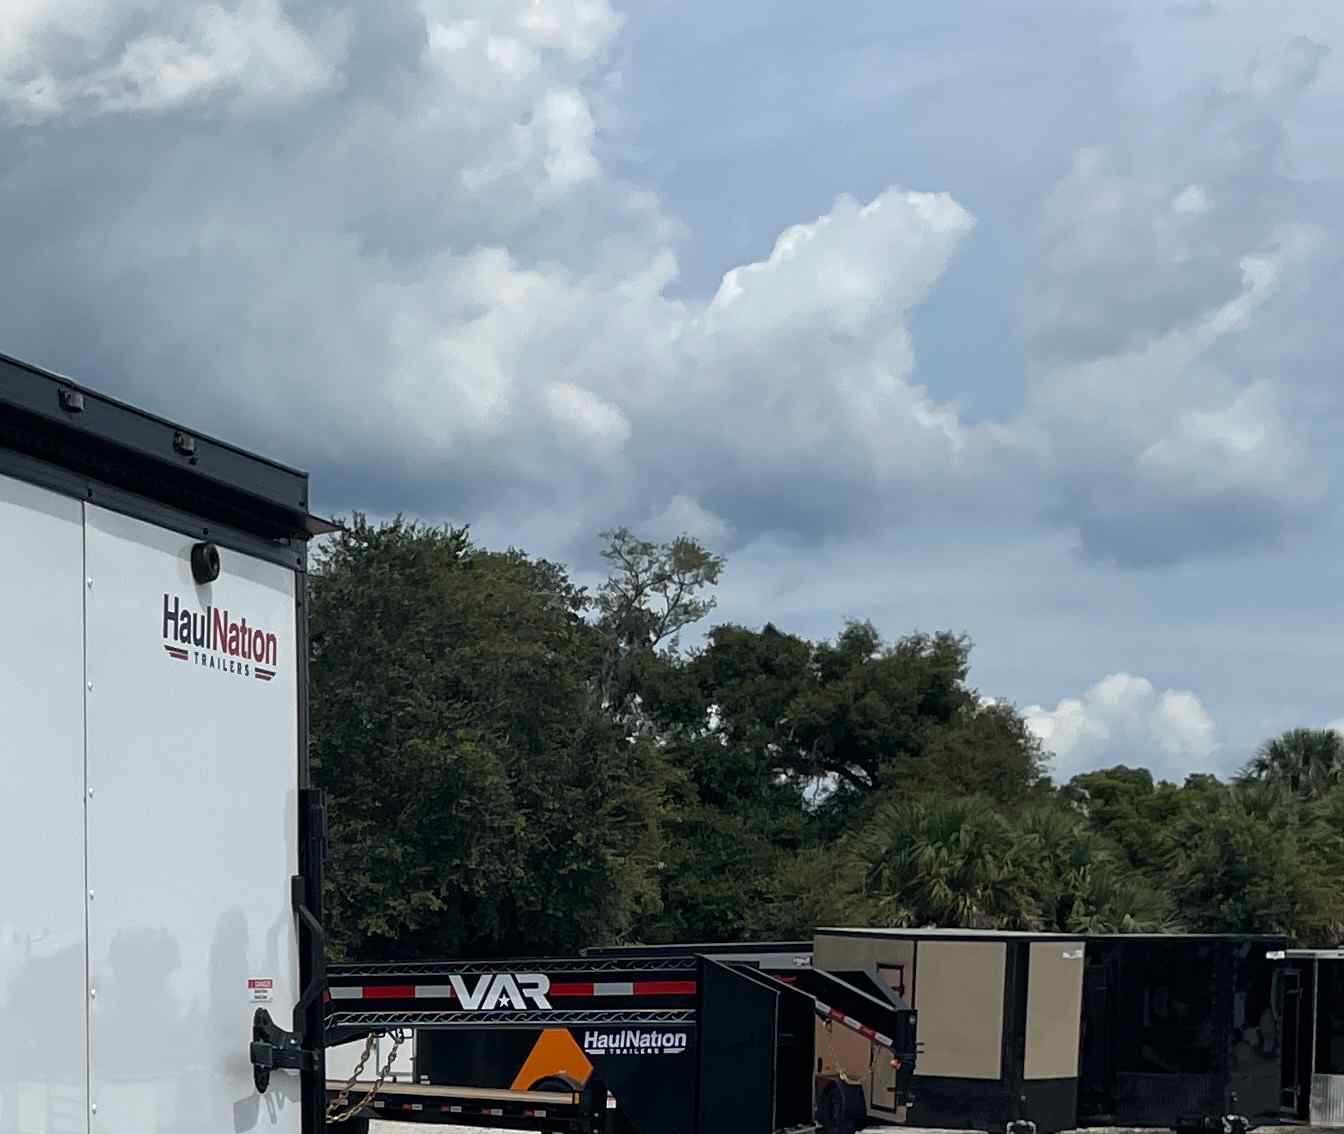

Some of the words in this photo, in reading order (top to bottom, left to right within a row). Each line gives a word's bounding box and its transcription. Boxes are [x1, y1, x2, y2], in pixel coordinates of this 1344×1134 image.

[162, 593, 277, 667] HaulNation
[193, 651, 250, 677] TRAILERS
[448, 973, 553, 1010] VAR
[584, 1030, 687, 1049] HaulNation
